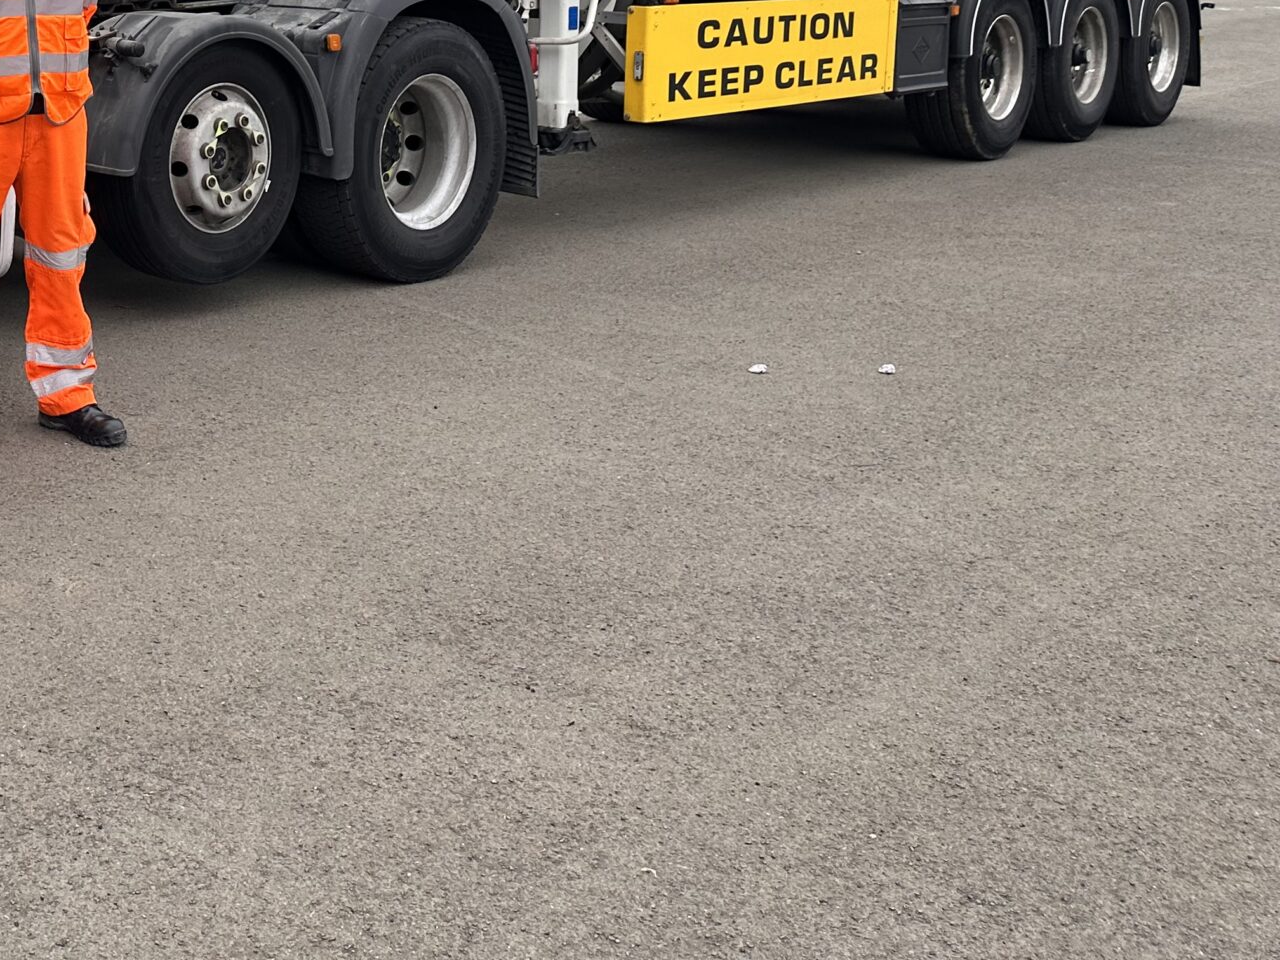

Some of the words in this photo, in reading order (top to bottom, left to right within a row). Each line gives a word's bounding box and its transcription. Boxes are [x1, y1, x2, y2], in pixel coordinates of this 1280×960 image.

[697, 11, 855, 49] CAUTION
[667, 64, 764, 103] KEEP
[775, 53, 878, 90] CLEAR
